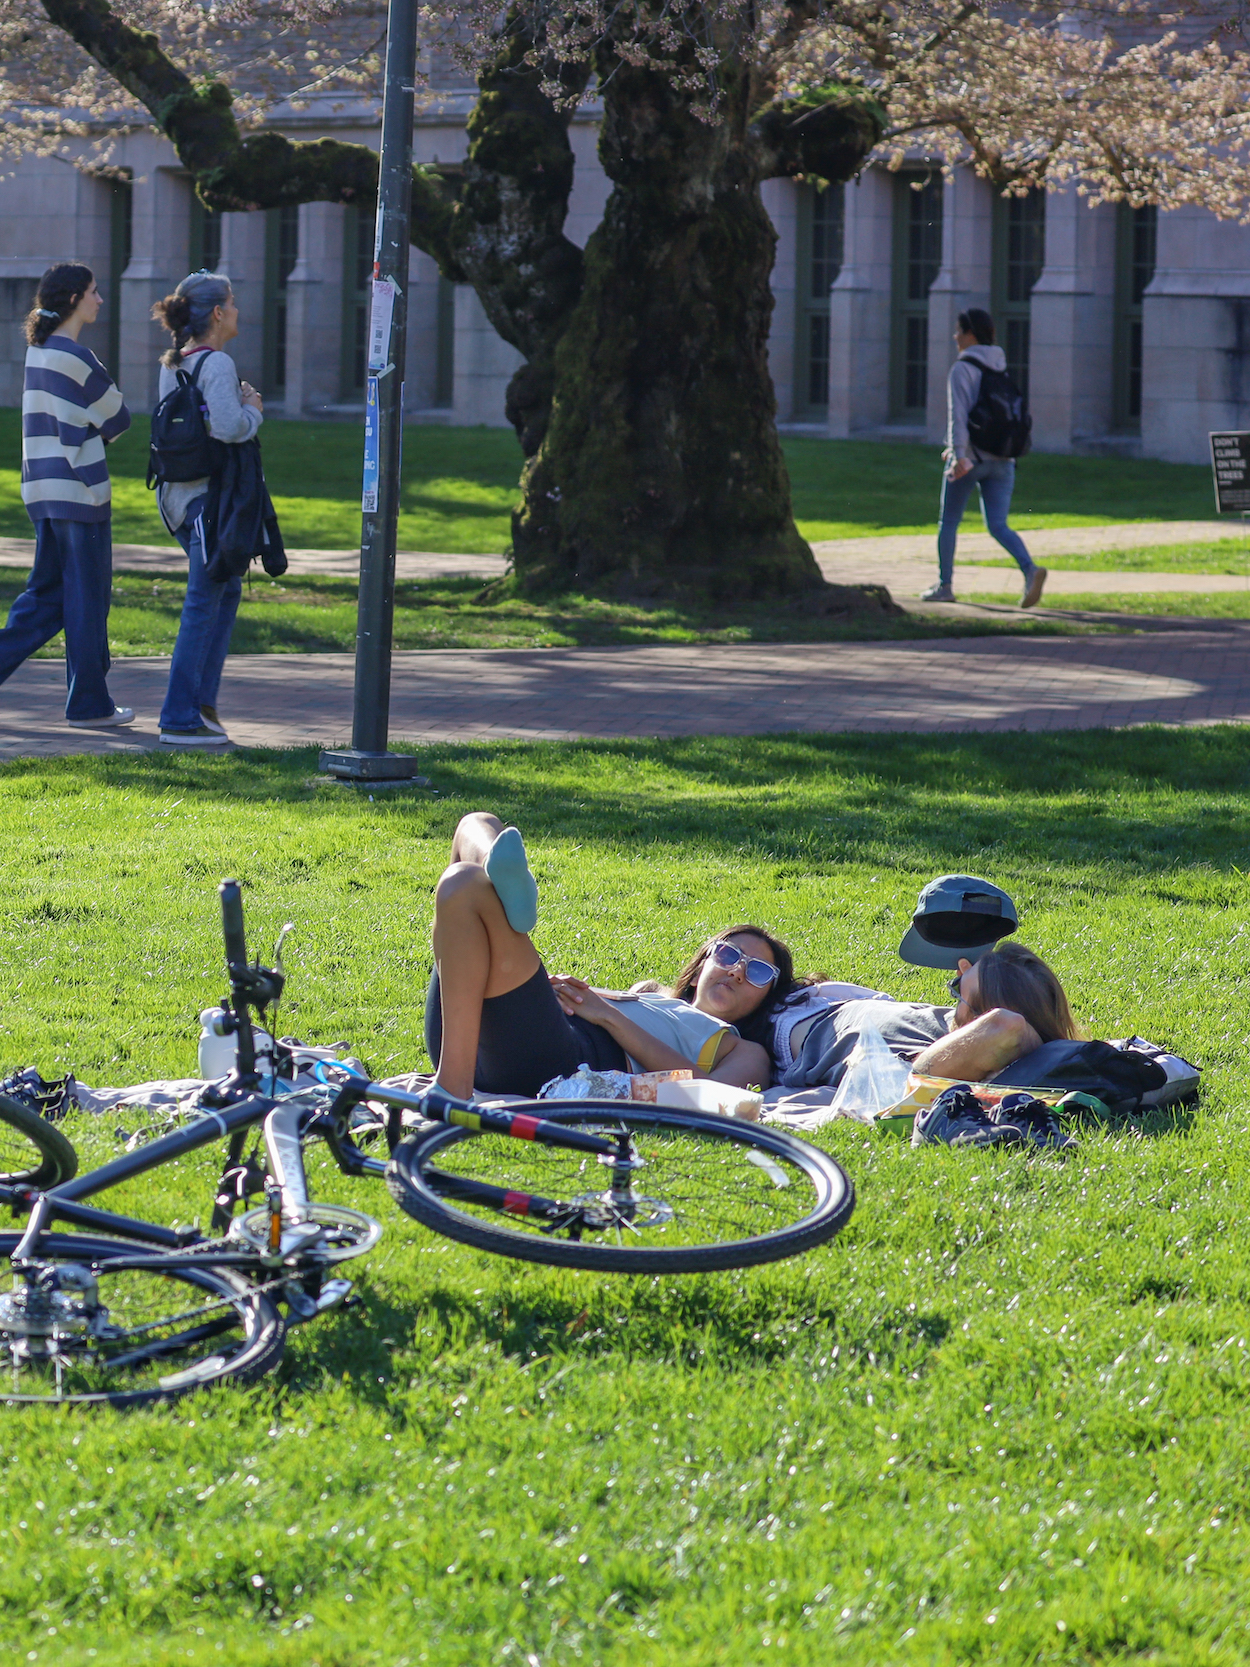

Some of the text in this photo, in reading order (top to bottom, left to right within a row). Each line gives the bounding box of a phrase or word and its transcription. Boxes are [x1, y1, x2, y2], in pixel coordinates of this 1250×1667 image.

[1213, 437, 1240, 447] DON'T
[1215, 449, 1241, 458] CLIMB
[1216, 459, 1247, 469] ON THE
[1218, 470, 1245, 480] TREES
